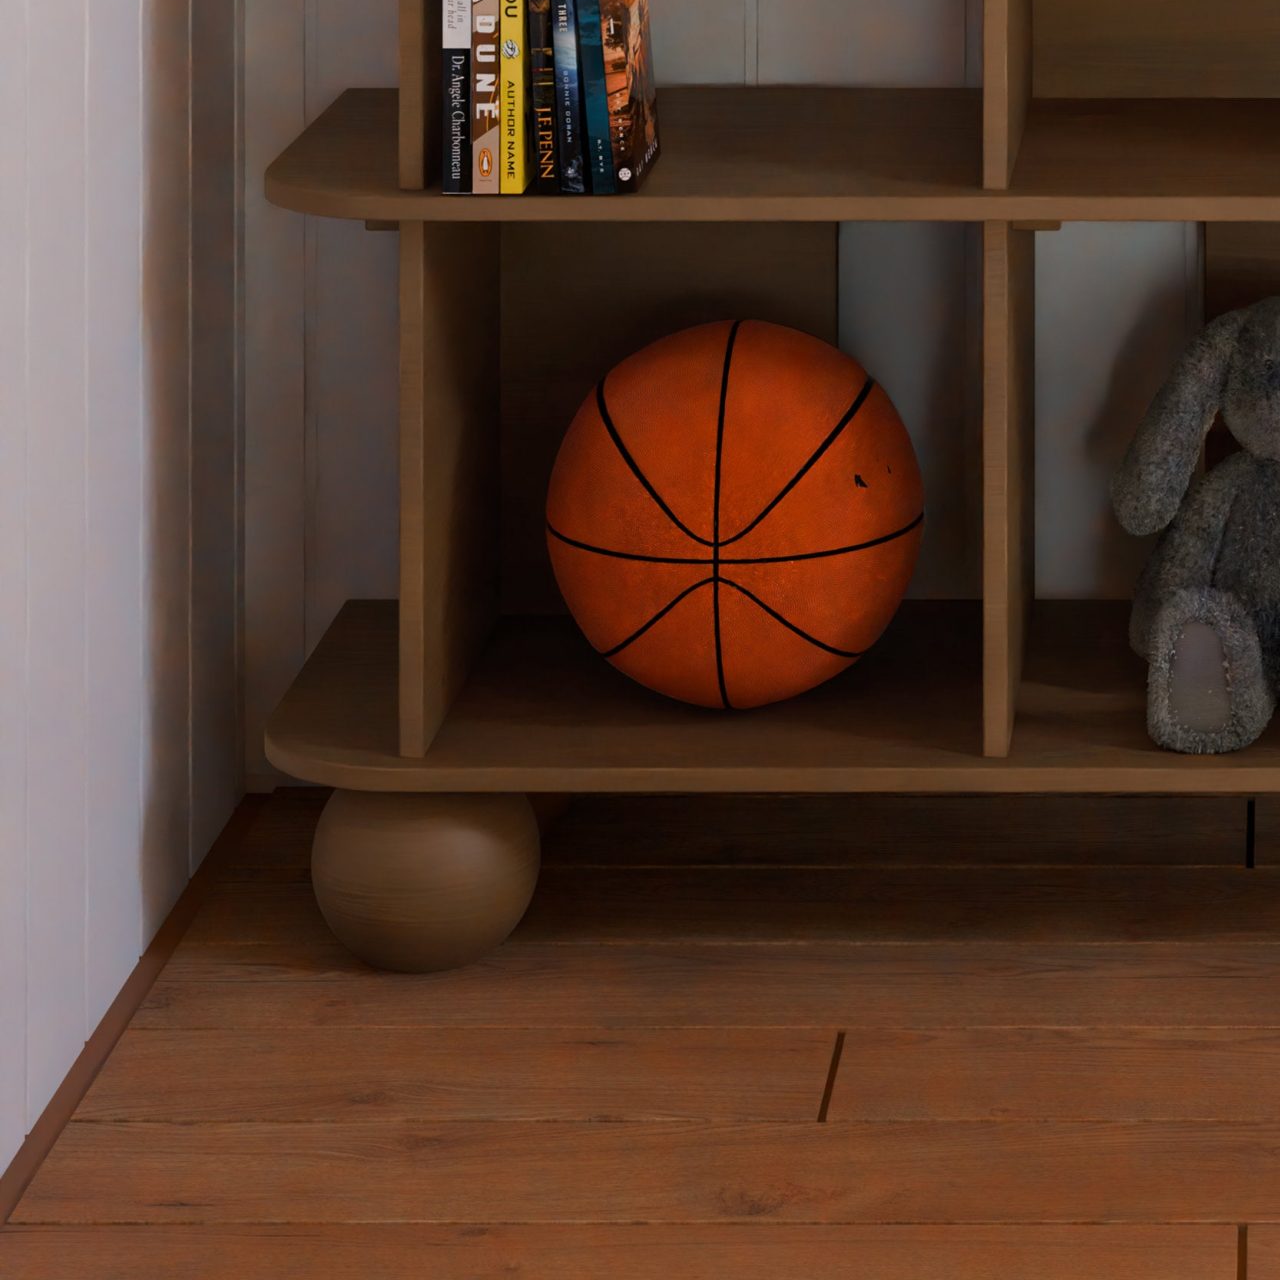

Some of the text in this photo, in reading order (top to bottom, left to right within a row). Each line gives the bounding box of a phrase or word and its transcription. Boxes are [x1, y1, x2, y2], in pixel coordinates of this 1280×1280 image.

[447, 10, 457, 30] head
[557, 4, 568, 33] THREE
[476, 15, 496, 119] DUNE
[449, 55, 466, 179] Dr. Angele Charbonneau
[507, 80, 516, 179] AUTHOR NAME
[565, 110, 573, 143] DORAN
[539, 131, 555, 178] PENN
